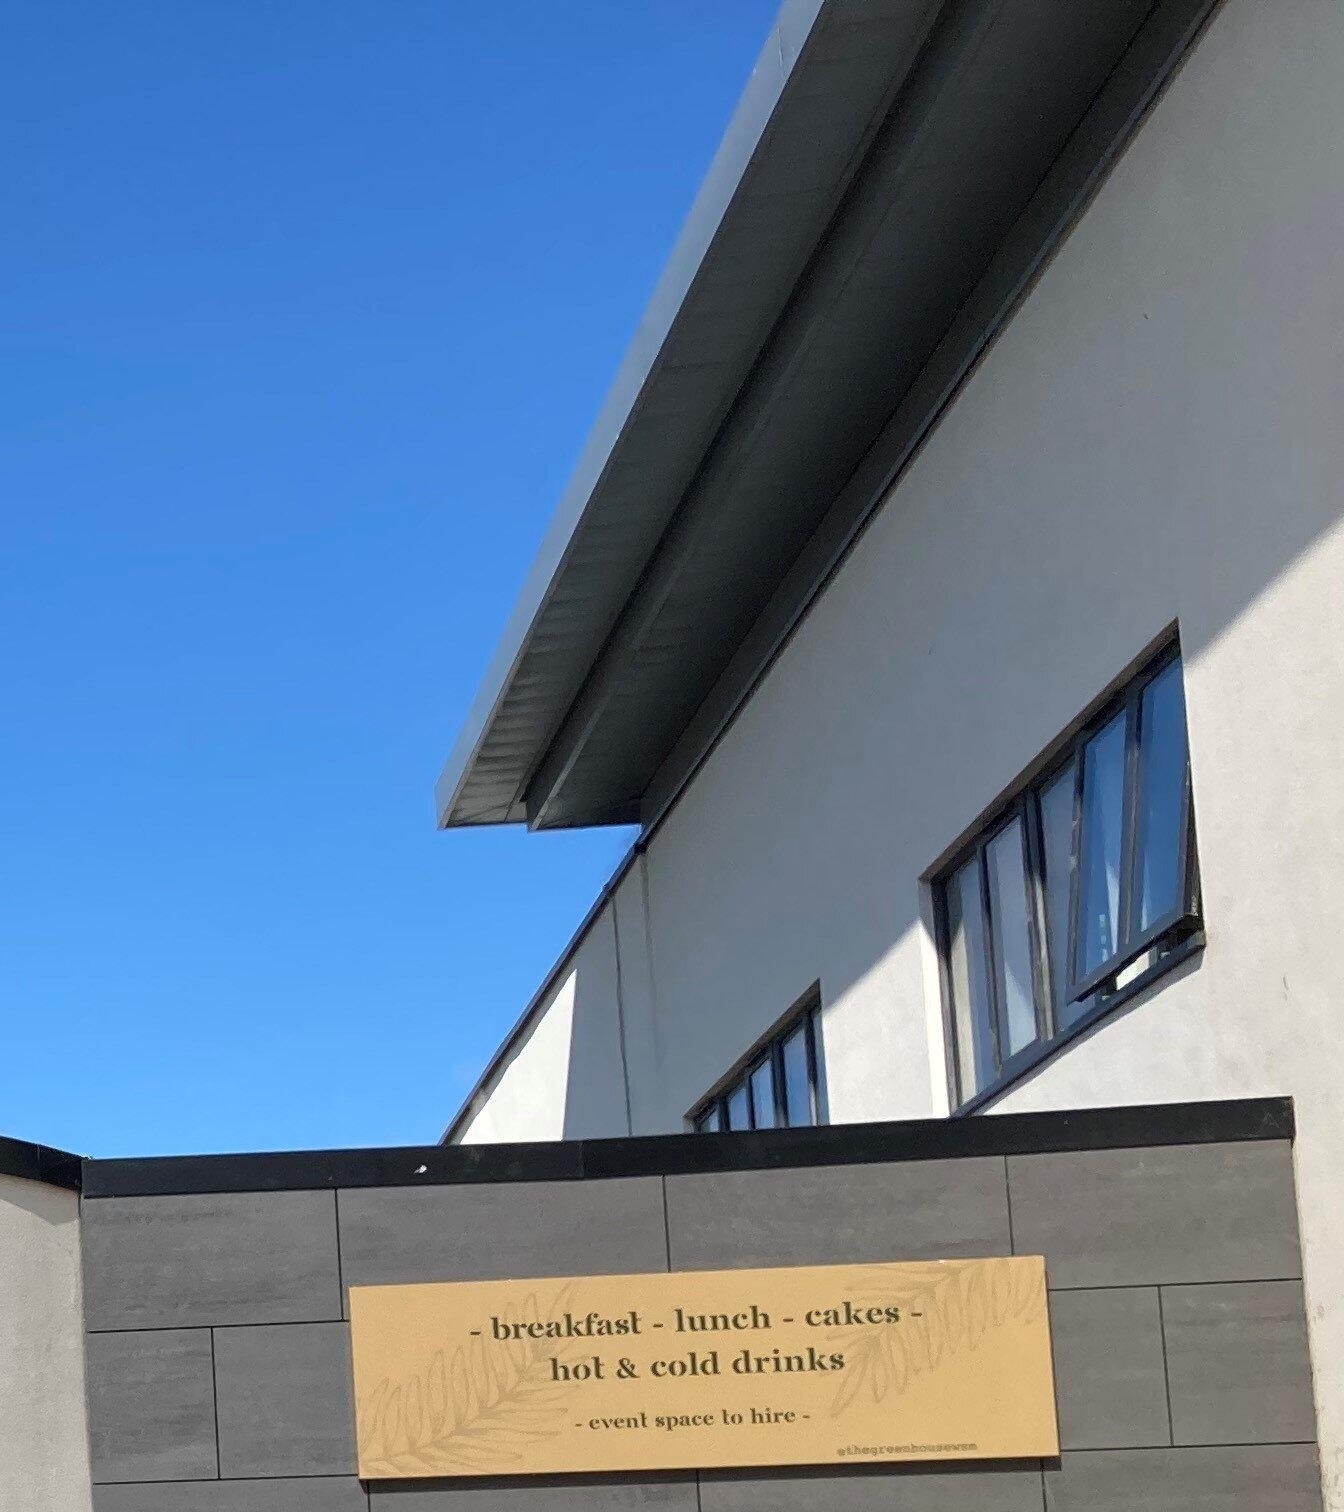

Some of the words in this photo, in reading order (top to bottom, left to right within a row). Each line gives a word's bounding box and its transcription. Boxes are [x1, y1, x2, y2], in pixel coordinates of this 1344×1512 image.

[491, 1309, 643, 1341] breakfast
[674, 1304, 772, 1333] lunch
[803, 1301, 901, 1328] cakes
[549, 1354, 605, 1383] hot
[616, 1358, 640, 1380] &
[650, 1350, 721, 1378] cold
[731, 1346, 846, 1373] drinks
[588, 1412, 649, 1431] event
[655, 1410, 715, 1432] space
[722, 1409, 744, 1426] to
[750, 1406, 797, 1425] hire
